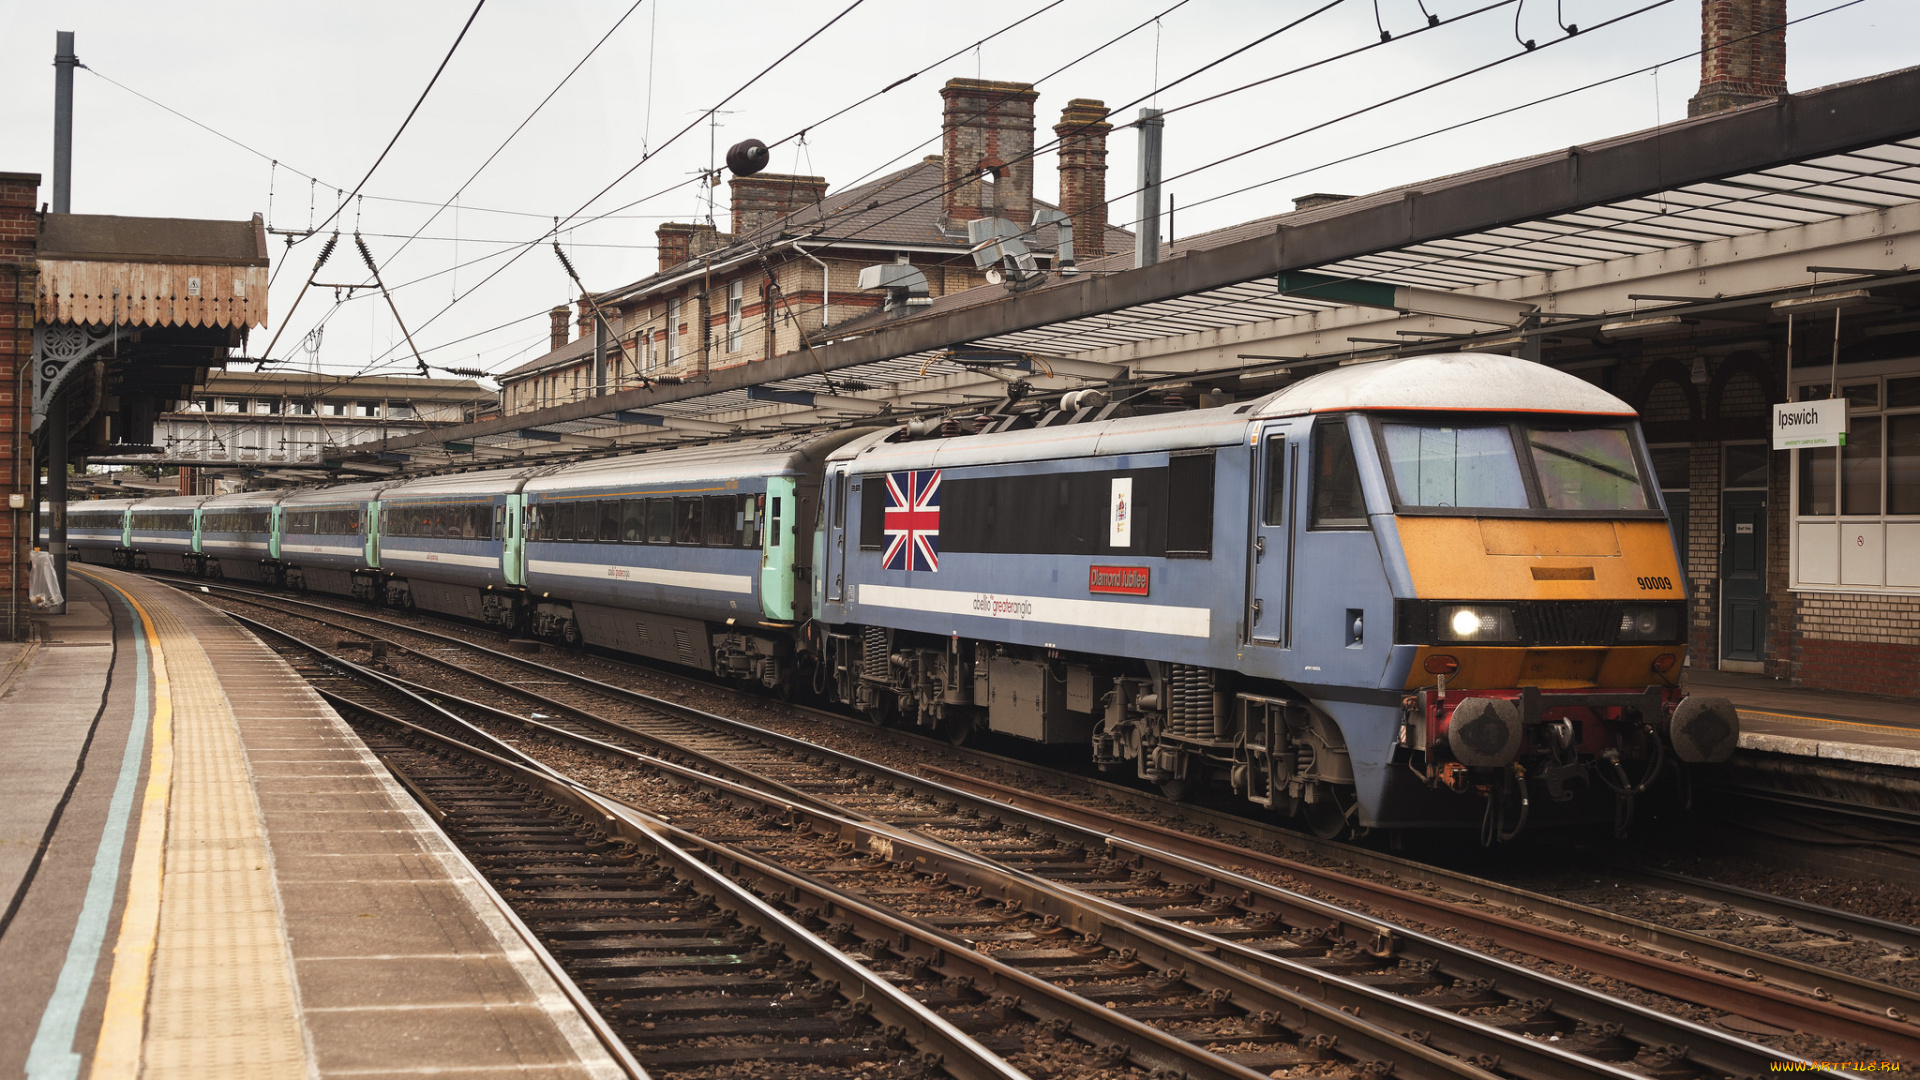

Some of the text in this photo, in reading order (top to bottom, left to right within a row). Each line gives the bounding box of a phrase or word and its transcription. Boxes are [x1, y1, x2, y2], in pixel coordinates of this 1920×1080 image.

[1778, 408, 1818, 430] Ipswich
[1091, 569, 1146, 589] Diamond Jubilee
[1637, 576, 1672, 590] 90009
[973, 593, 1031, 619] abellio greateranglia
